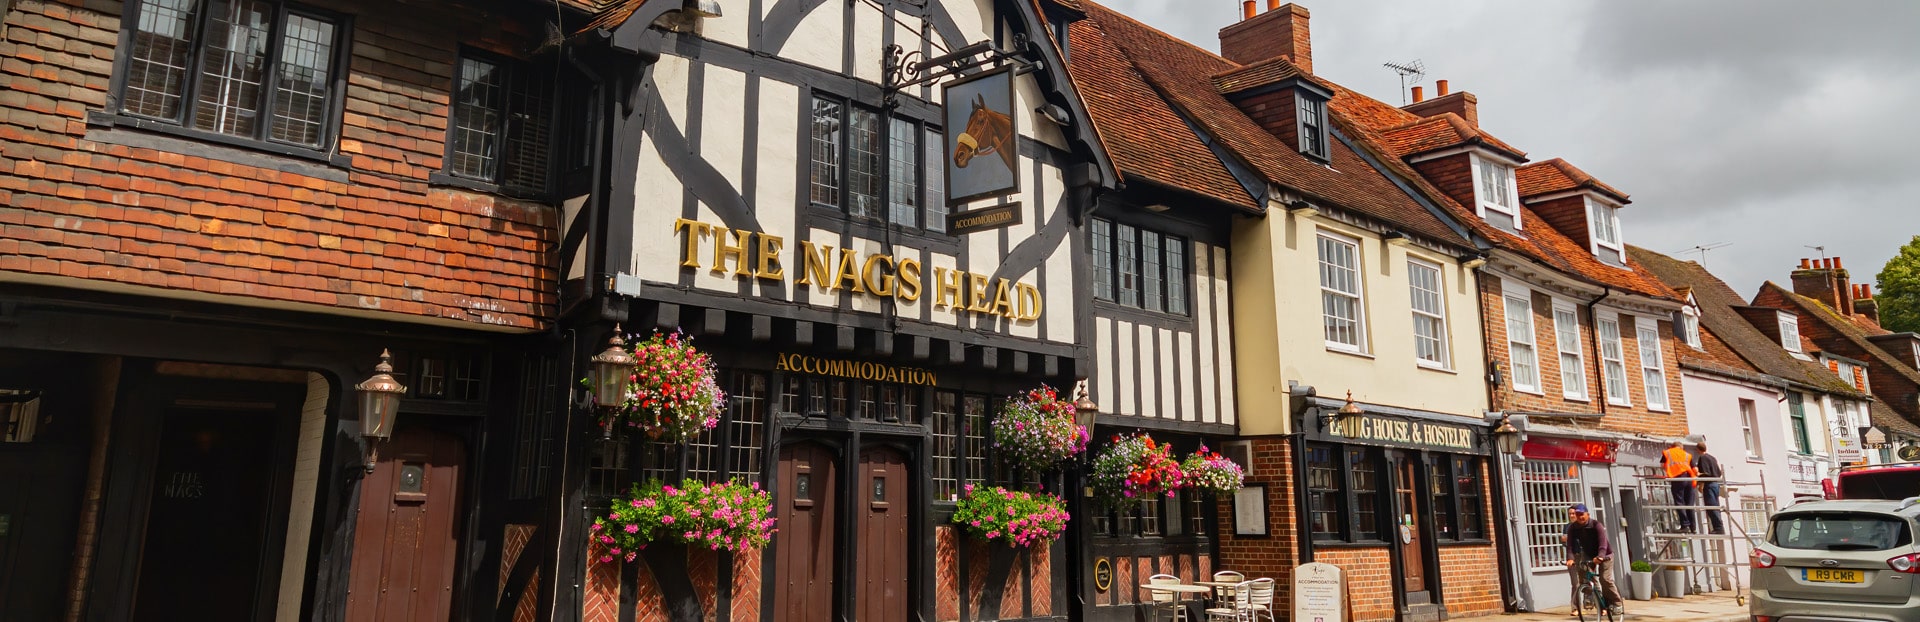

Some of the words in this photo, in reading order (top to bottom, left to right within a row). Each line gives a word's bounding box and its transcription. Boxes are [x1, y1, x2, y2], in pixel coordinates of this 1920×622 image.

[955, 211, 1012, 229] ACCOMMODATION
[675, 218, 784, 281] THE
[795, 240, 923, 301] NAGS
[934, 266, 1043, 321] HEAD
[776, 352, 937, 387] ACCOMMODATION
[1372, 418, 1410, 443] HOUSE
[1411, 422, 1423, 445] &
[1423, 424, 1472, 449] HOSTELRY
[1816, 569, 1830, 579] R9
[1833, 570, 1854, 580] CMR
